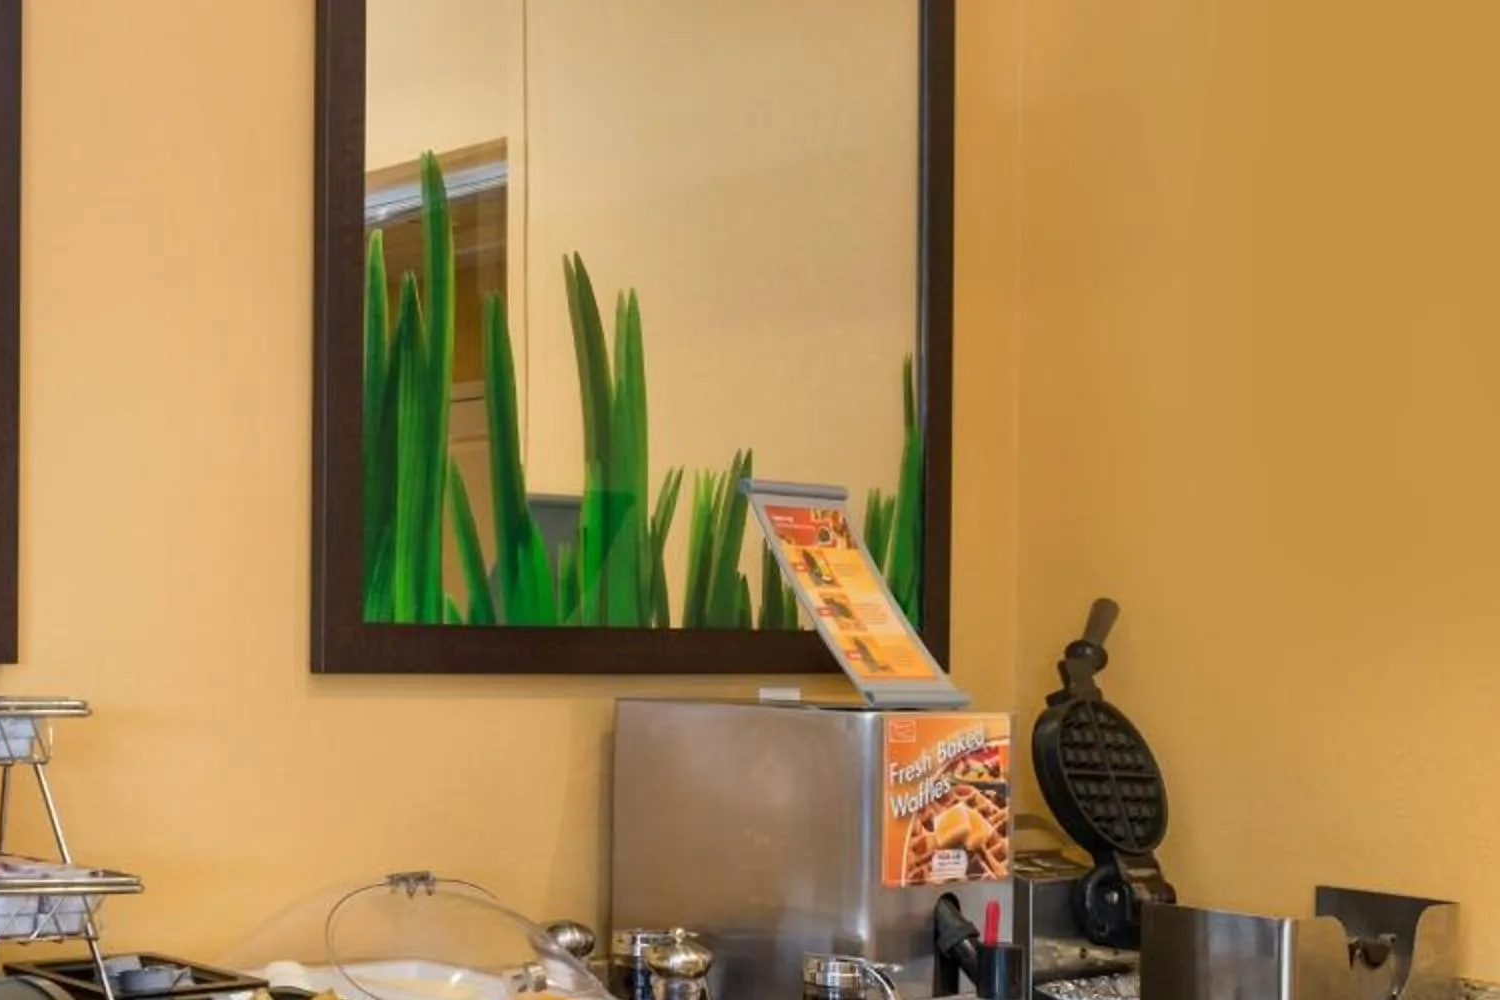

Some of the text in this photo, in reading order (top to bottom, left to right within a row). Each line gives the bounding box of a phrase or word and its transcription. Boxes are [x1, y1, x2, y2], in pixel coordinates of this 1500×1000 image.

[889, 751, 932, 787] Fresh
[937, 723, 986, 762] Baked
[889, 775, 952, 818] Waffles
